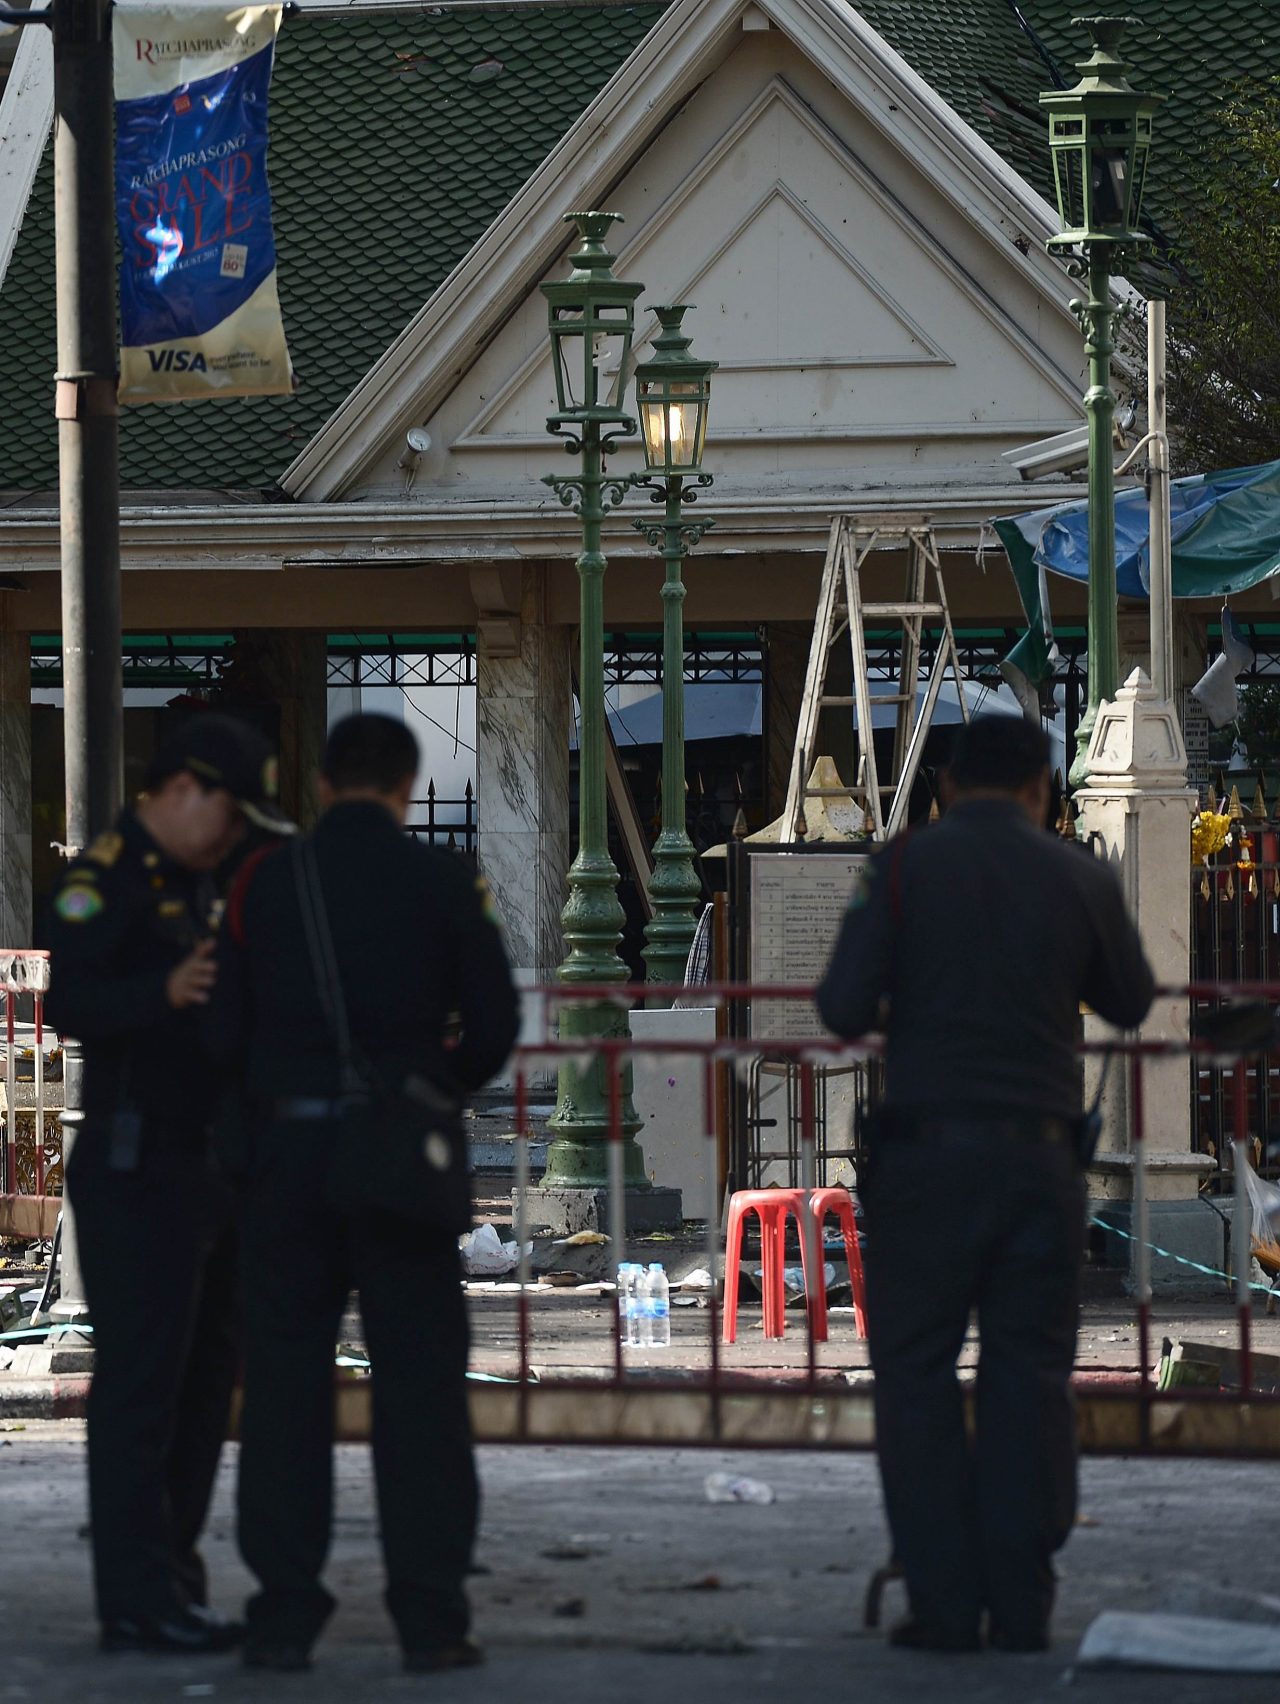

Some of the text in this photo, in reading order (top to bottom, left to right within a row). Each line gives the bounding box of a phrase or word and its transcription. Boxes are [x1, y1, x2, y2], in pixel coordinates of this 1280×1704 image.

[136, 35, 256, 65] RATCHAPRASNG
[130, 133, 247, 190] RATCHAPRASONG
[130, 152, 252, 223] GRAND
[134, 186, 254, 268] SALE
[145, 350, 208, 373] VISA
